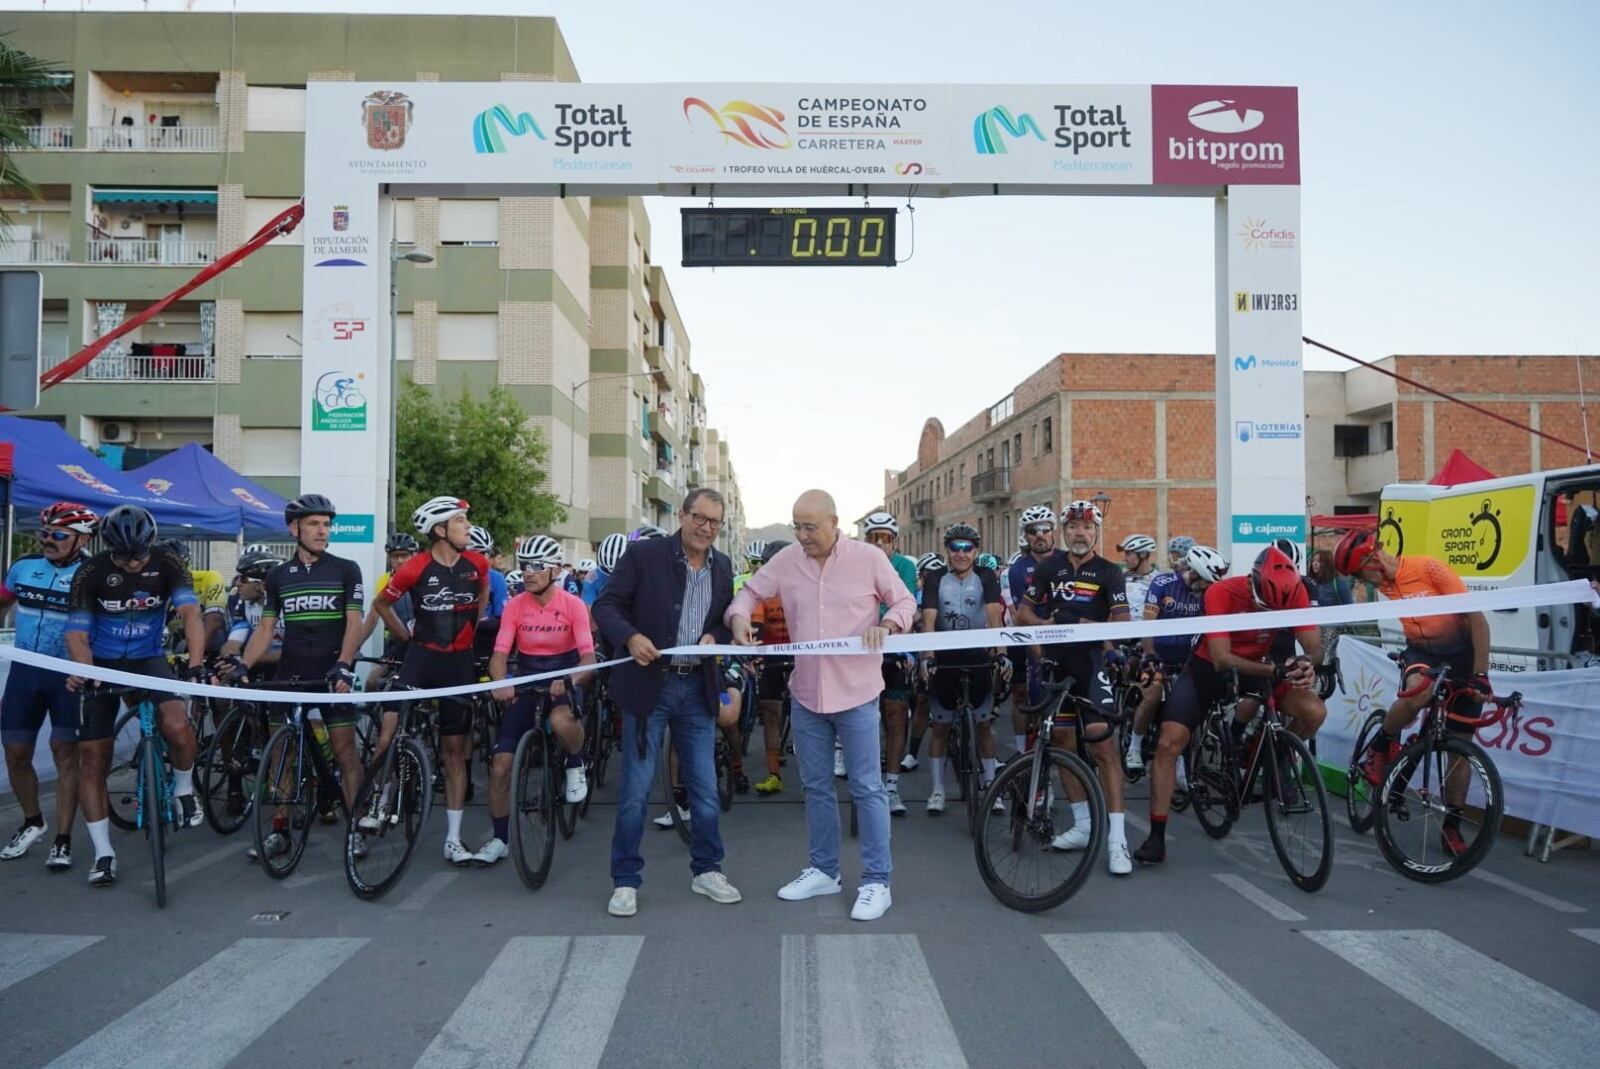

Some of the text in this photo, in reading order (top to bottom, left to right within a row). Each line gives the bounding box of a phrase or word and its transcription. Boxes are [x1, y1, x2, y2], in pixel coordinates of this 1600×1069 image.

[797, 98, 927, 111] CAMPEONATO
[554, 103, 628, 126] Total
[797, 112, 901, 128] DE ESPAÑA
[1053, 104, 1127, 127] Total
[554, 125, 632, 154] Sport
[797, 138, 886, 150] CARRETERA
[1054, 127, 1132, 155] Sport
[1168, 136, 1284, 165] bitprom
[348, 159, 428, 168] AYUNTAMIENTO
[553, 158, 633, 170] Mediterranean
[729, 165, 766, 174] TROFEO
[767, 165, 793, 174] VILLA
[795, 165, 808, 174] DE
[809, 164, 886, 174] HUÉRCAL-OVERA
[1053, 159, 1133, 171] Mediterranean
[1217, 161, 1285, 170] regalo promocional
[312, 235, 369, 245] DIPUTACIÓN
[1250, 228, 1296, 240] Cofidis
[313, 246, 326, 255] DE
[1261, 358, 1299, 368] Movistar
[330, 522, 367, 535] ajamar
[1255, 523, 1298, 535] cajamar
[1441, 528, 1472, 539] CRONO
[1445, 541, 1476, 552] SPORT
[1448, 554, 1477, 565] RADIO
[284, 595, 338, 613] SRBK
